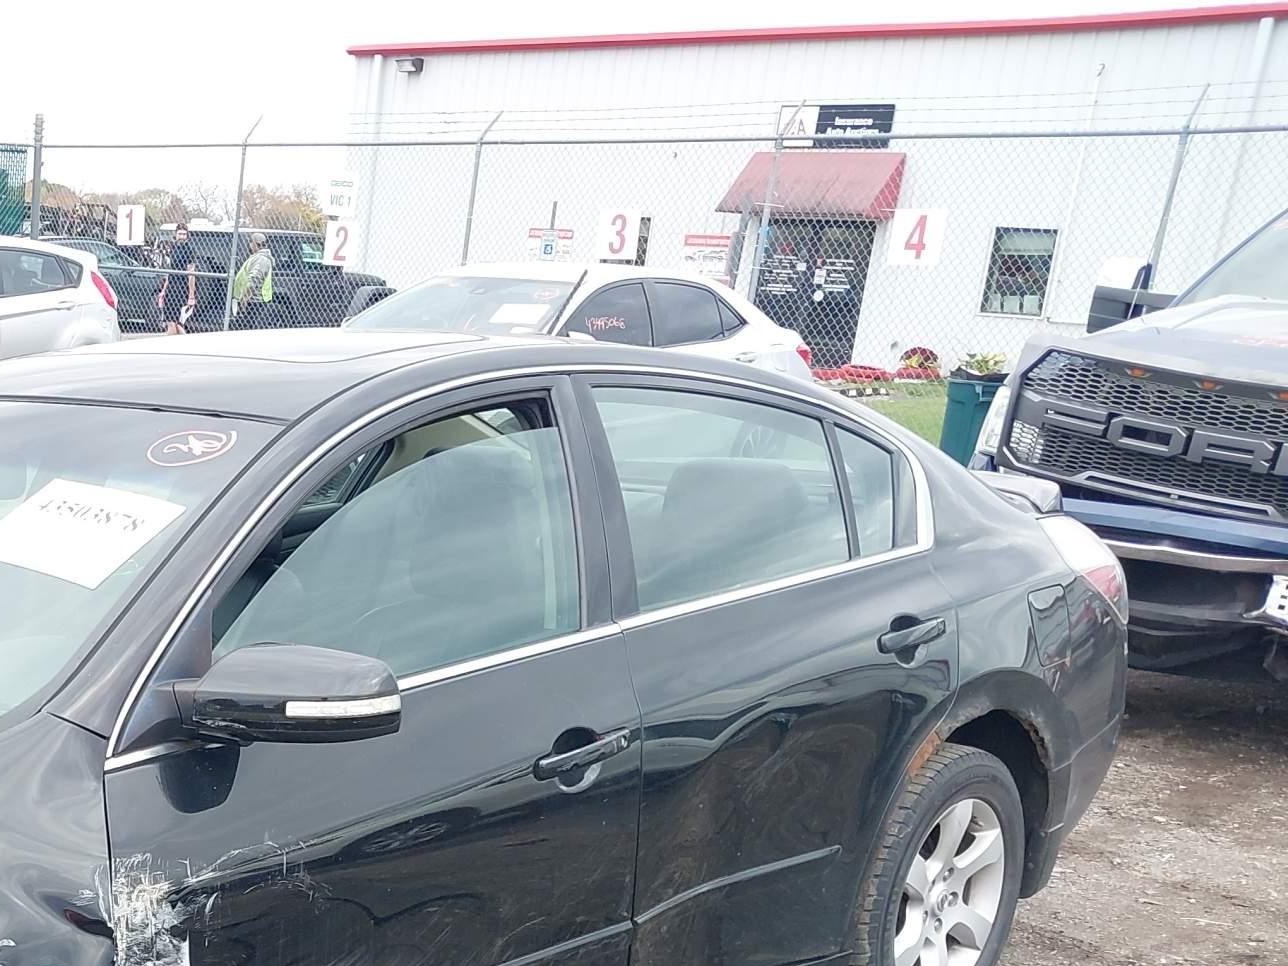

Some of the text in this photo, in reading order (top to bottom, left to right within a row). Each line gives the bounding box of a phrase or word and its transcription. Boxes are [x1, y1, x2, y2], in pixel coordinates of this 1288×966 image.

[125, 208, 133, 241] 1
[333, 226, 349, 261] 2
[608, 214, 627, 254] 3
[904, 215, 928, 260] 4
[1015, 391, 1288, 477] FOR
